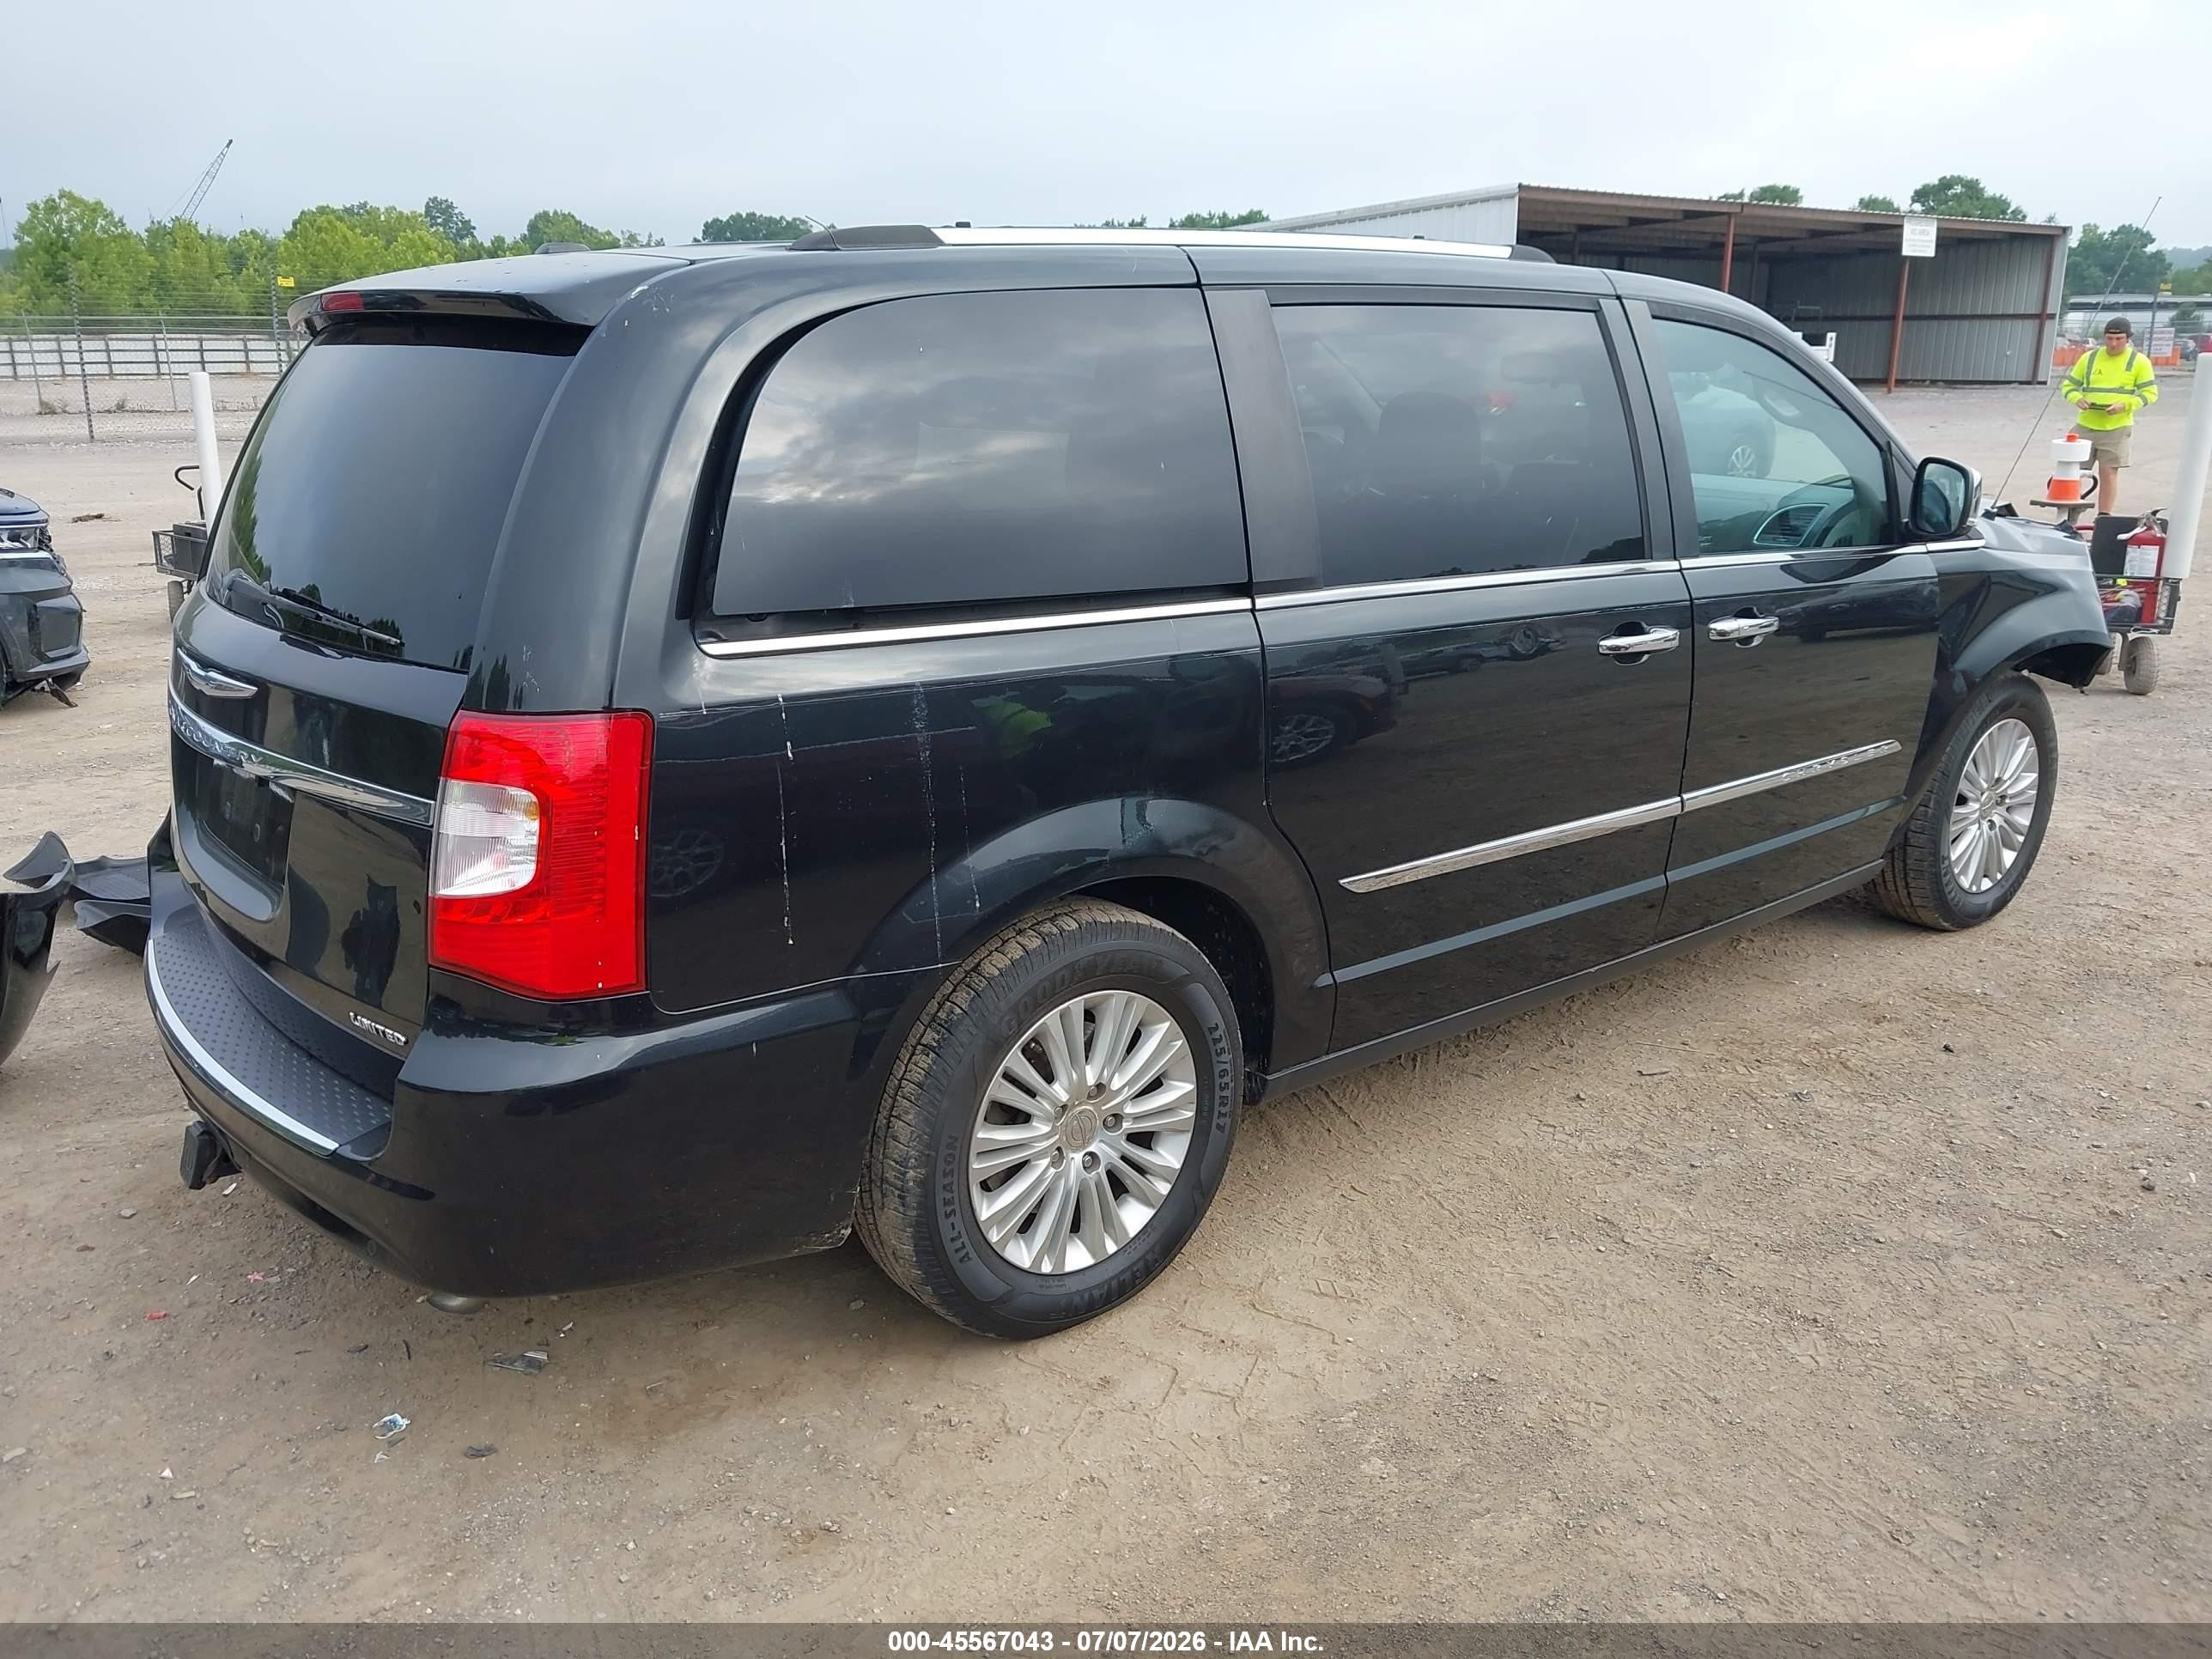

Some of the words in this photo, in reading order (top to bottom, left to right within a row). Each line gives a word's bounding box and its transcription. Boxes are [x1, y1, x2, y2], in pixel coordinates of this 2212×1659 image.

[186, 726, 263, 763] COUNTRY
[1780, 744, 1891, 782] CHRYSLER
[348, 1011, 408, 1047] LIMITED
[1206, 1022, 1231, 1134] 225/65R17
[942, 1133, 972, 1265] ALL-SEASON
